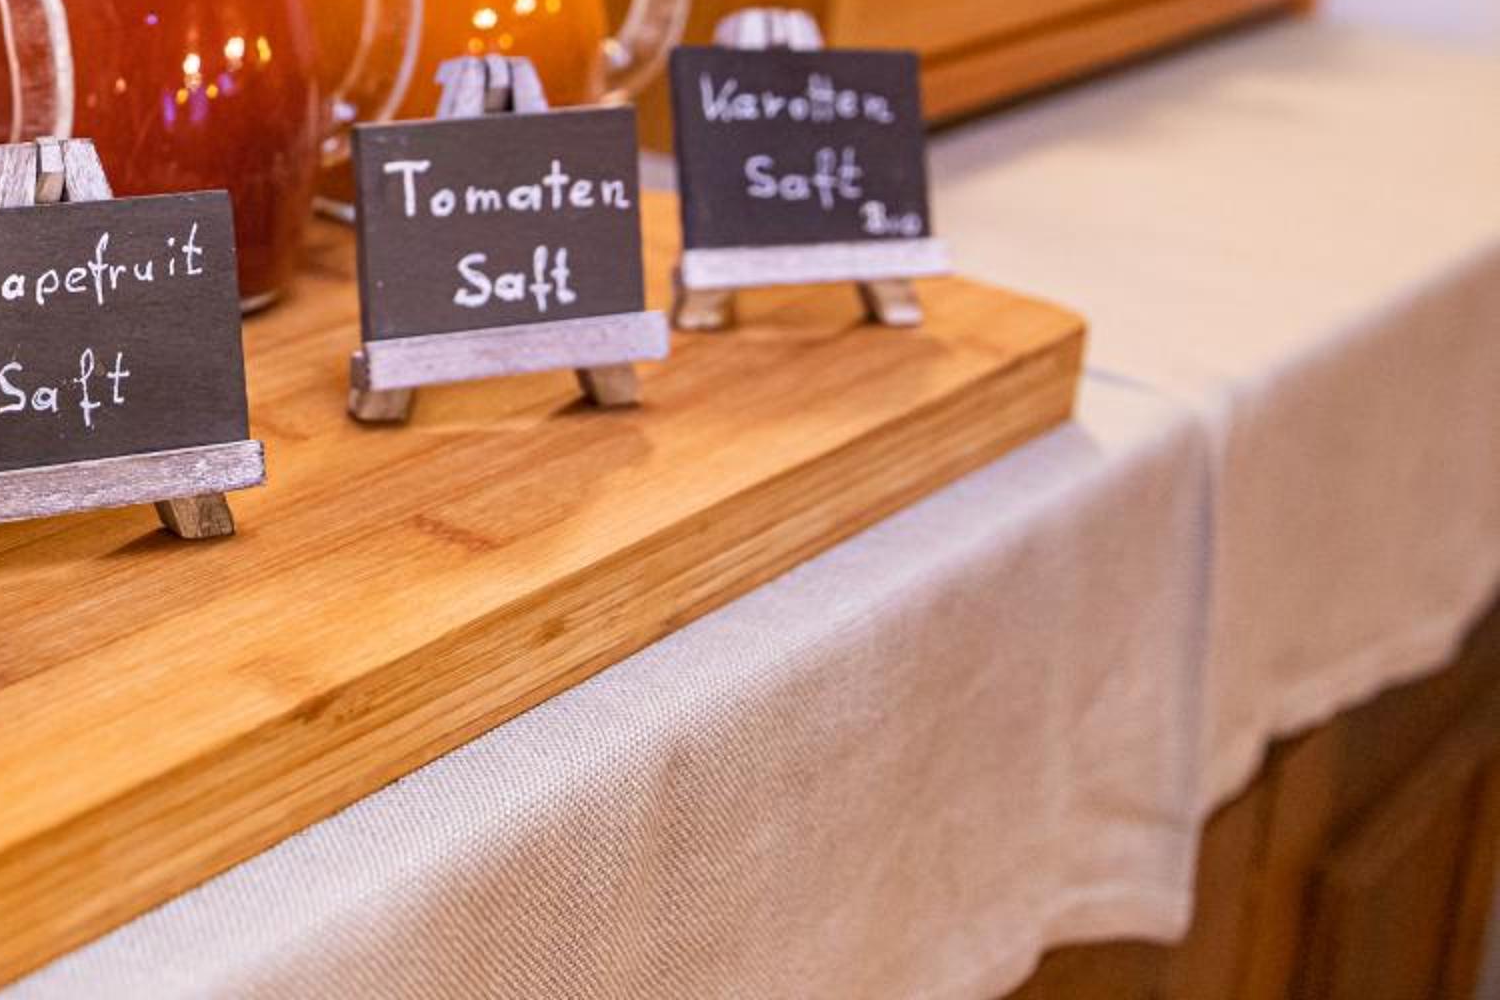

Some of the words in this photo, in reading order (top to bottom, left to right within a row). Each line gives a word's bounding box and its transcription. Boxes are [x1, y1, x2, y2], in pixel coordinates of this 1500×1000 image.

[700, 72, 895, 124] Karotten
[383, 159, 631, 217] Tomaten
[744, 146, 863, 210] Saft
[453, 245, 577, 312] Saft
